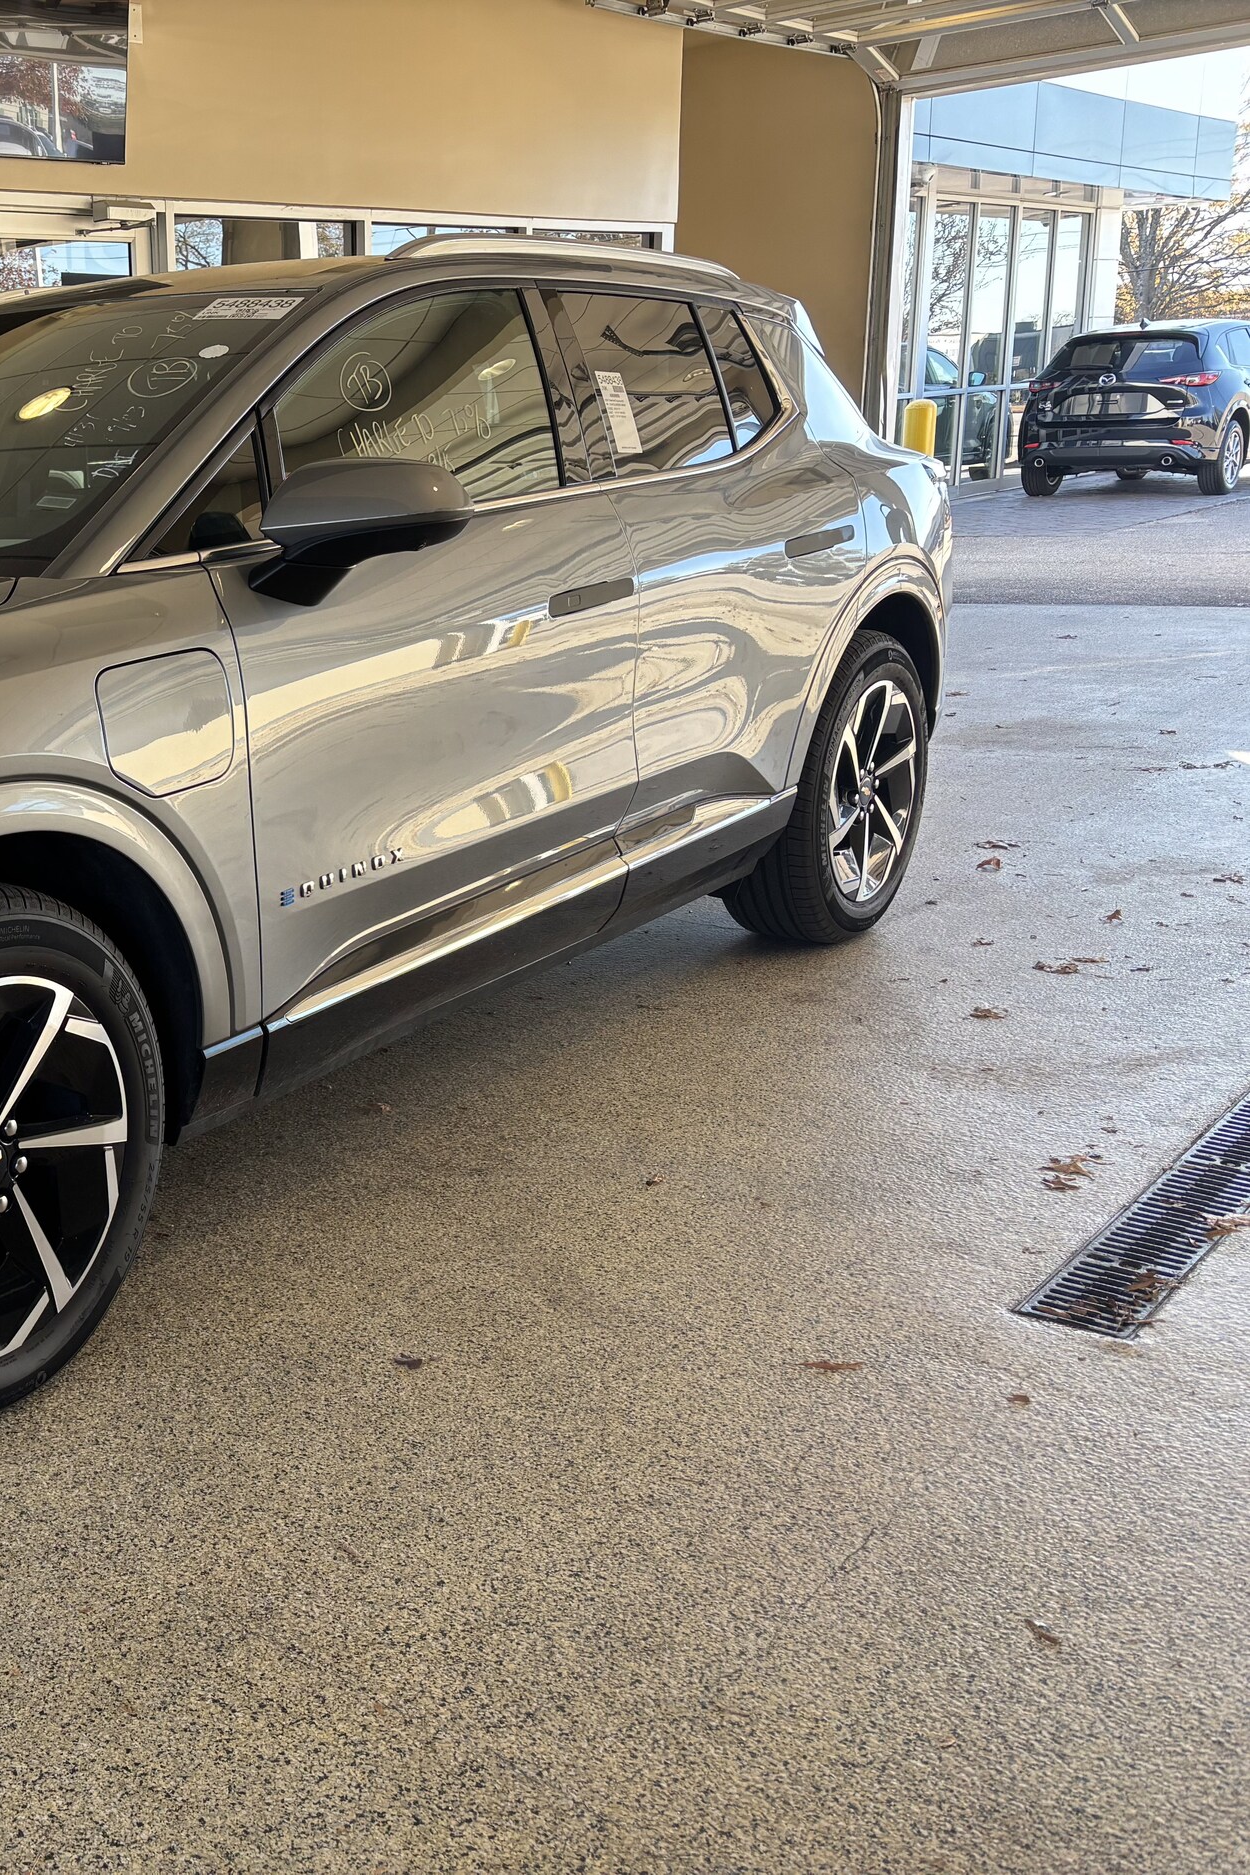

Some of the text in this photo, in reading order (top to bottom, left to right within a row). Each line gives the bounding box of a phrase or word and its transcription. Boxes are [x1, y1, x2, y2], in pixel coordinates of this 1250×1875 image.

[212, 299, 296, 309] 5488438
[280, 848, 405, 906] EQUINOX
[0, 925, 30, 934] MICHELIN
[128, 1010, 159, 1138] MICHELIN
